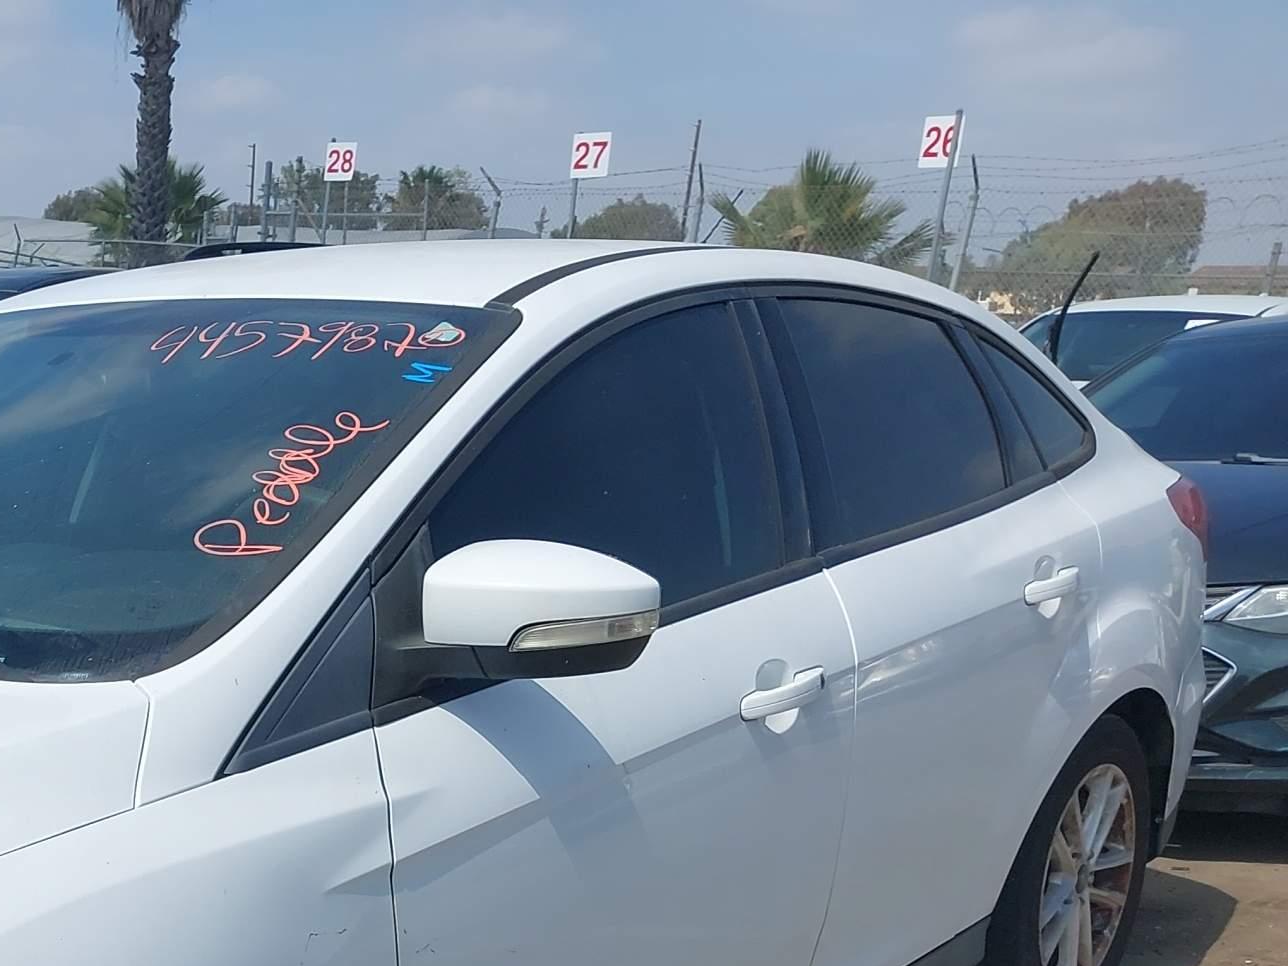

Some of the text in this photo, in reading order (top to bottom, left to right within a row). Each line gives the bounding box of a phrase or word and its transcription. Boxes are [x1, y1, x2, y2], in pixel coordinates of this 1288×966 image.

[326, 149, 354, 173] 28
[573, 140, 608, 170] 27
[150, 321, 466, 364] 44579870
